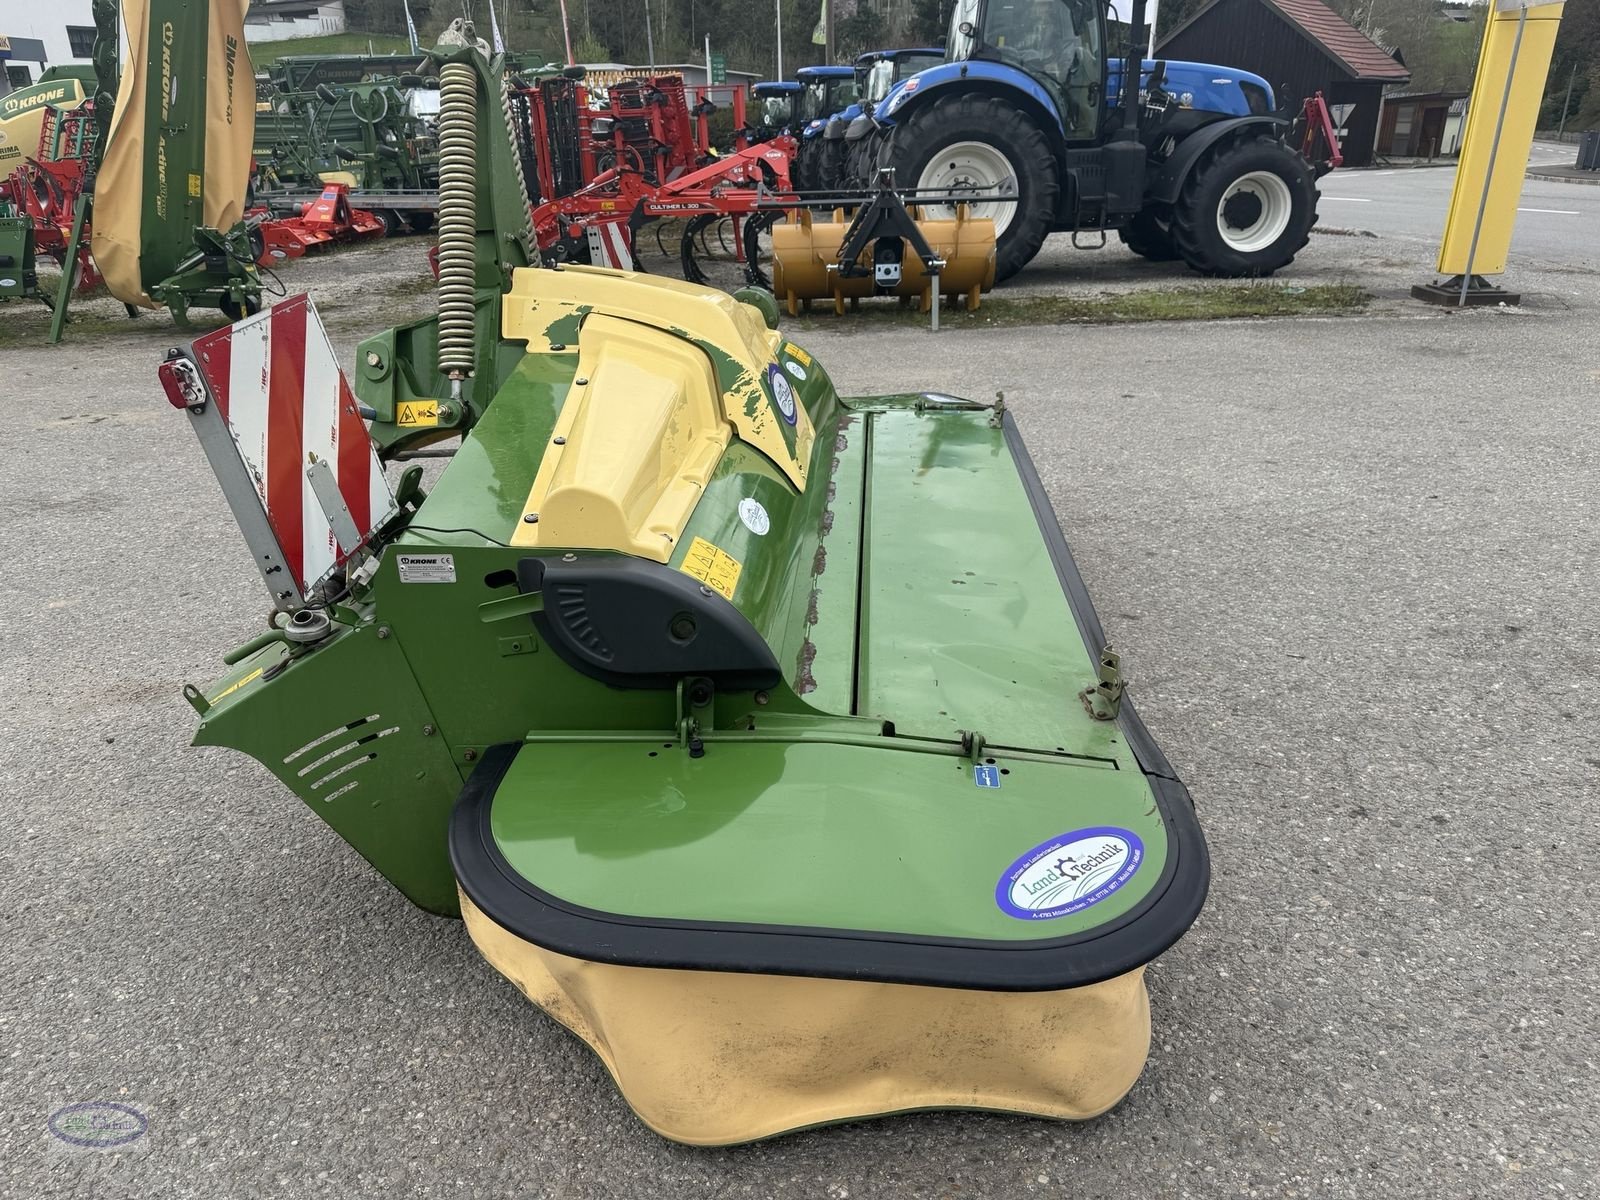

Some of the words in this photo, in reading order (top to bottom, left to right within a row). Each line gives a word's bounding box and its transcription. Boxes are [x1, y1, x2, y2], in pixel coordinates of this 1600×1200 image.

[161, 45, 173, 122] KRONE
[19, 88, 65, 109] KRONE
[1071, 844, 1123, 876] Technik
[1021, 869, 1059, 896] Land
